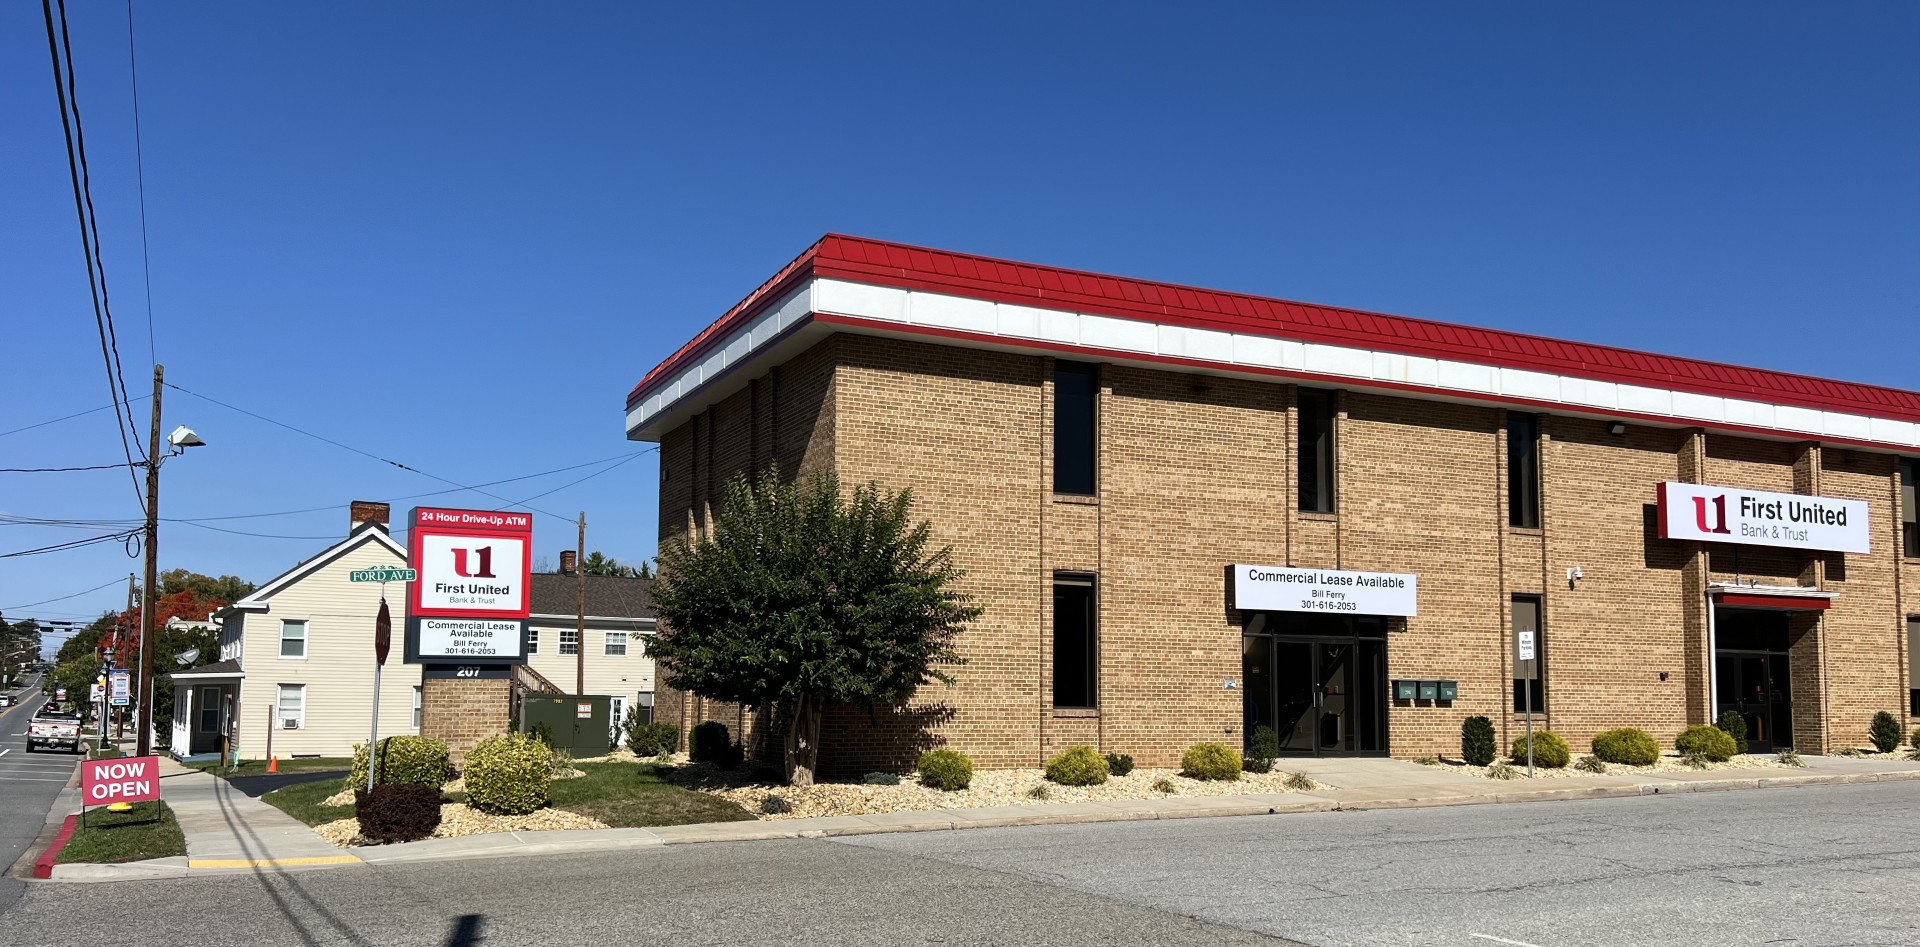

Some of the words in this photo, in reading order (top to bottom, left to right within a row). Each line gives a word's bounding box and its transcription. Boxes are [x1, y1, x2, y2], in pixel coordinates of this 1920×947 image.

[1740, 496, 1783, 520] First
[1789, 501, 1847, 526] United
[422, 512, 433, 520] 24
[436, 513, 460, 522] Hour
[462, 514, 503, 526] Drive-Up
[505, 516, 526, 526] ATM
[1741, 523, 1769, 538] Bank
[1771, 525, 1780, 539] &
[1782, 526, 1808, 541] Trust
[352, 571, 386, 582] FORD
[390, 570, 413, 580] AVE
[1249, 569, 1317, 584] Commercial
[1320, 573, 1353, 586] Lease
[1356, 575, 1405, 588] Available
[435, 583, 464, 594] First
[468, 584, 510, 595] United
[1311, 590, 1324, 598] Bill
[1326, 591, 1345, 600] Ferry
[477, 597, 496, 605] Trust
[1301, 600, 1357, 611] 301-616-2053
[427, 621, 485, 630] Commercial
[487, 622, 515, 630] Lease
[450, 630, 493, 638] Available
[468, 640, 488, 648] Ferry
[456, 666, 481, 677] 207
[95, 762, 145, 781] NOW
[92, 780, 150, 799] OPEN
